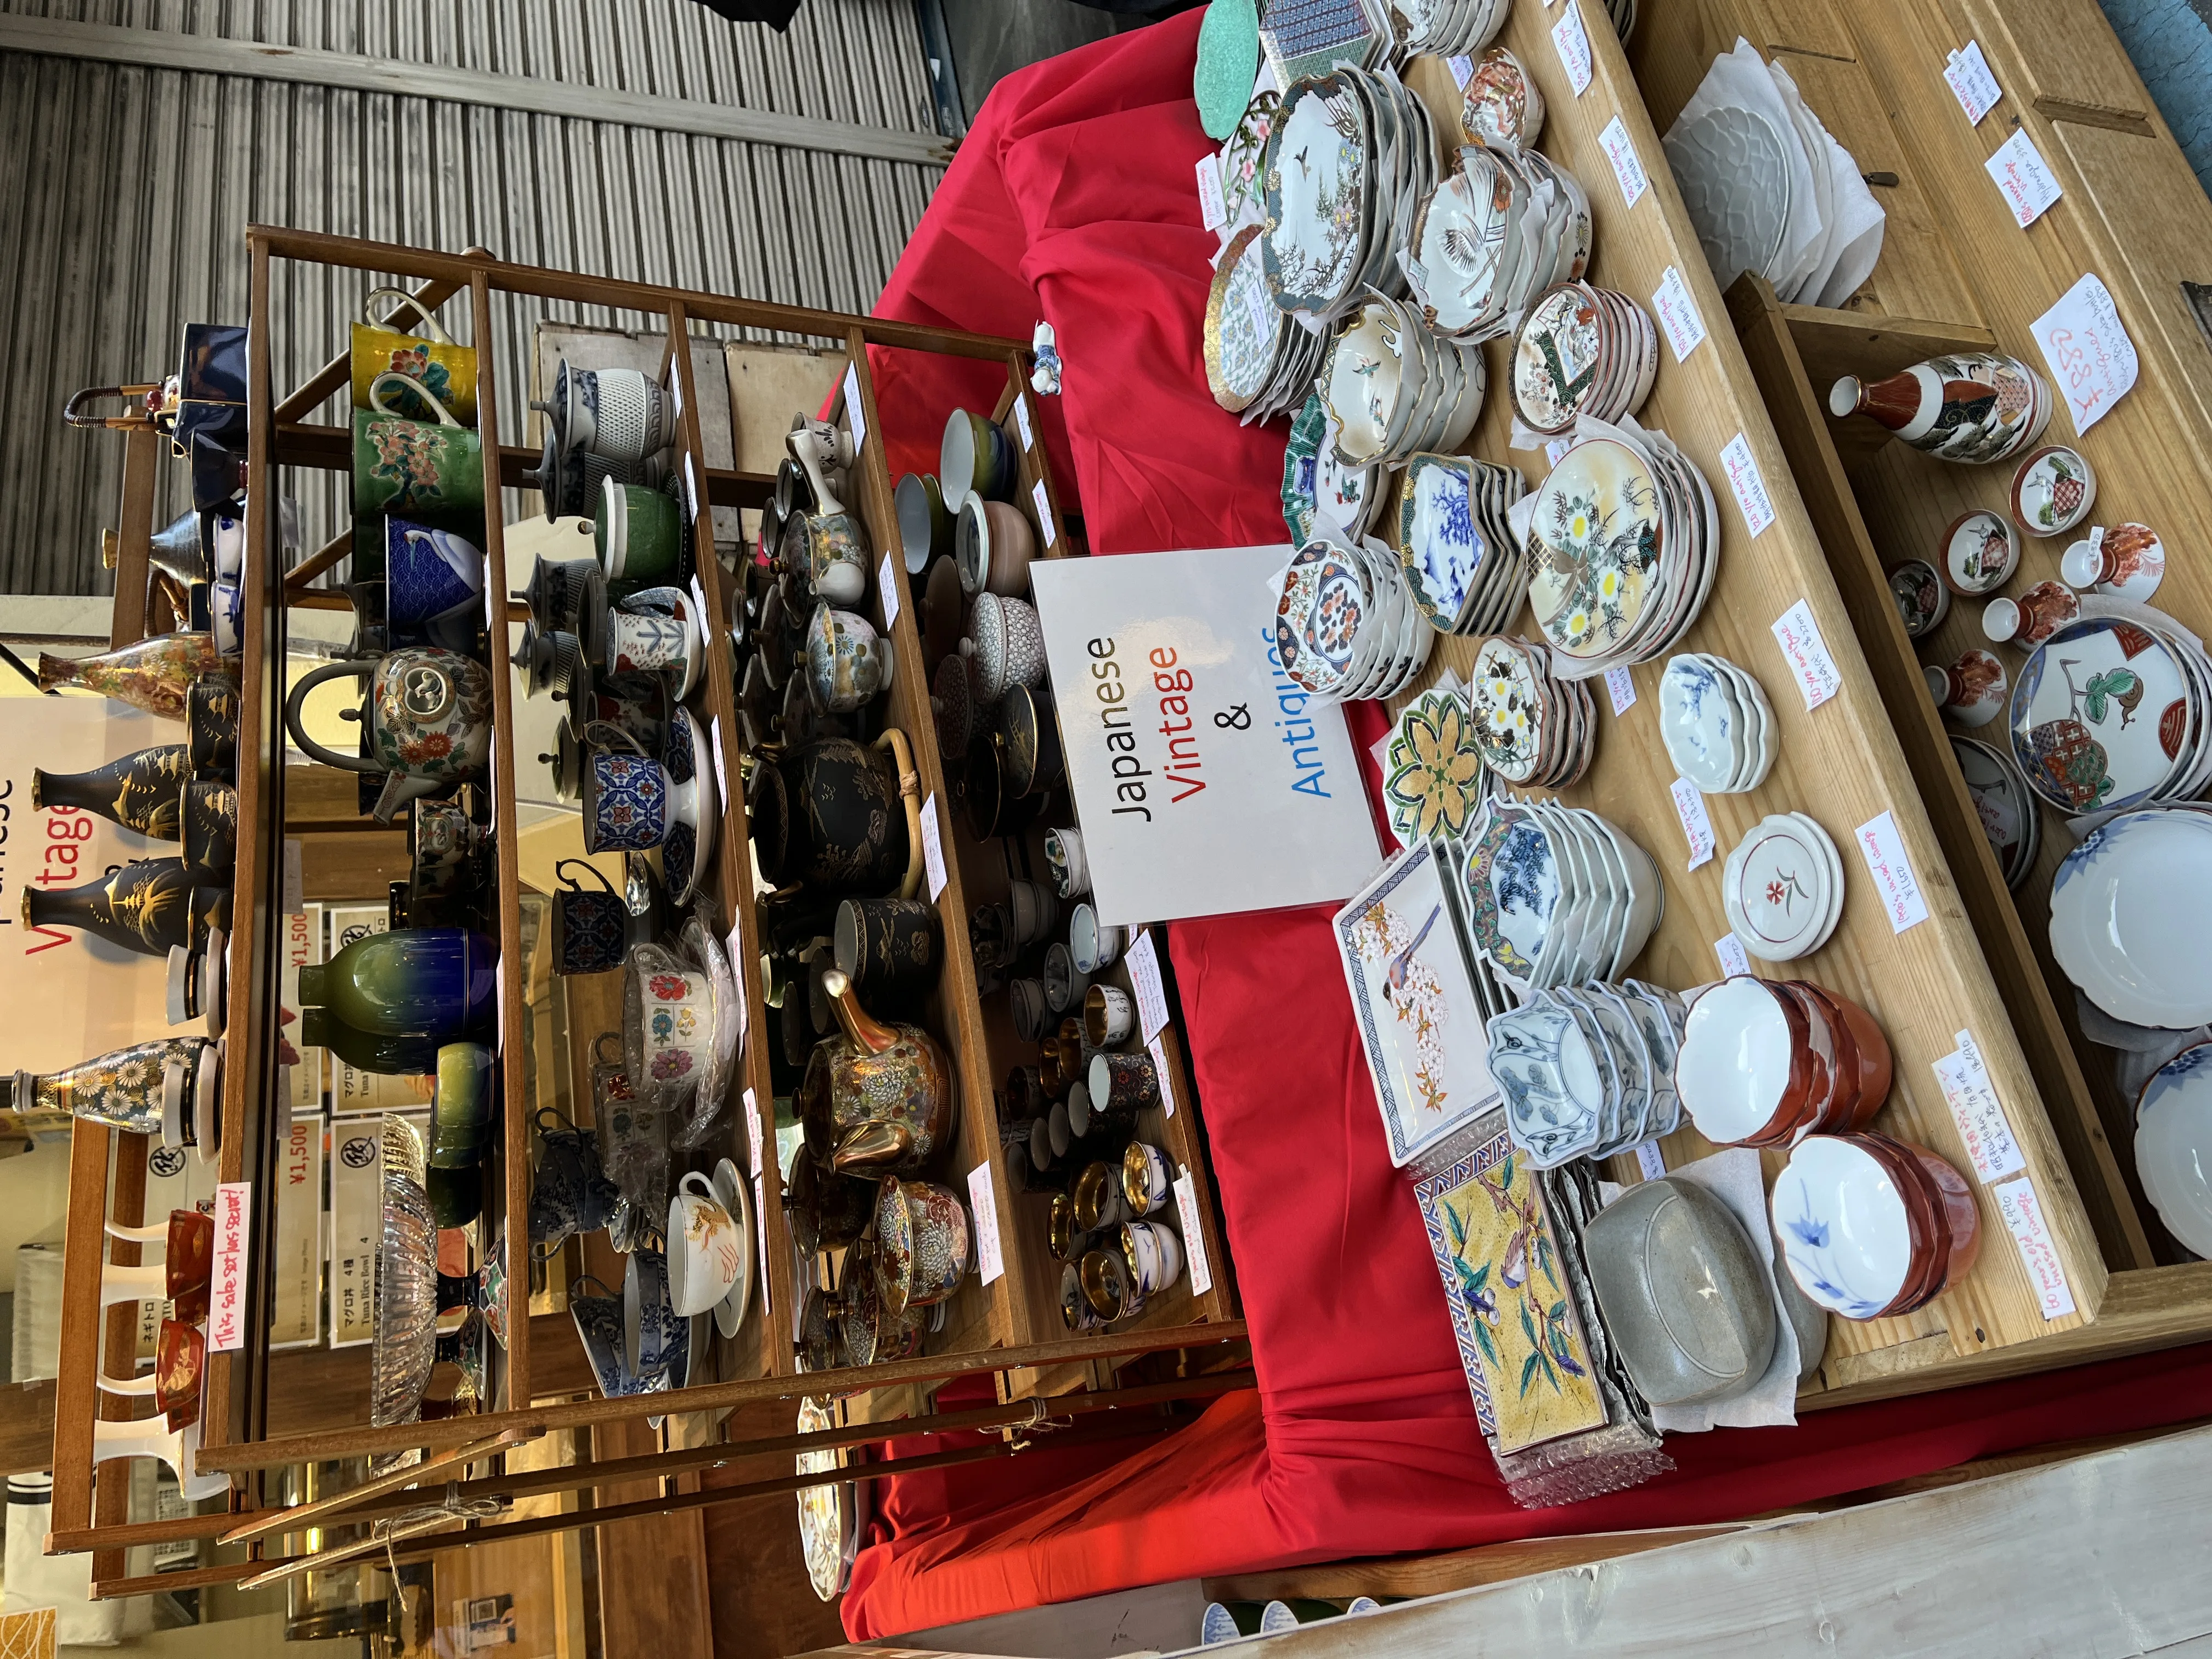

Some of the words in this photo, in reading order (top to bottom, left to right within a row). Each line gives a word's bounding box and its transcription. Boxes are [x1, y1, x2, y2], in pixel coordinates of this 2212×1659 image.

[2002, 178, 2023, 203] unused
[2025, 160, 2053, 204] Hydrangea
[1660, 295, 1677, 328] antique
[2084, 326, 2118, 396] antiques
[1728, 455, 1746, 495] antique
[1750, 513, 1762, 532] 120
[2086, 533, 2101, 558] ¥330
[1781, 623, 1807, 668] antique
[1086, 637, 1153, 822] Japanese
[1149, 647, 1206, 803] Vintage
[1214, 702, 1251, 731] &
[1864, 831, 1882, 859] vintage
[26, 805, 93, 955] Vtage
[1872, 859, 1897, 892] unused
[291, 913, 311, 967] ¥1,500
[360, 1075, 370, 1097] Tuna
[1939, 1069, 1989, 1172] 未使用ヴィンテージ
[290, 1126, 309, 1184] ¥1,500
[2002, 1195, 2021, 1228] ¥990
[2017, 1191, 2041, 1236] vintage
[2018, 1235, 2036, 1255] old
[2035, 1242, 2062, 1286] unused
[216, 1277, 237, 1308] sake
[344, 1288, 354, 1328] マグロ丼
[2045, 1294, 2061, 1309] 60
[215, 1313, 236, 1348] This
[360, 1301, 371, 1326] Tuna
